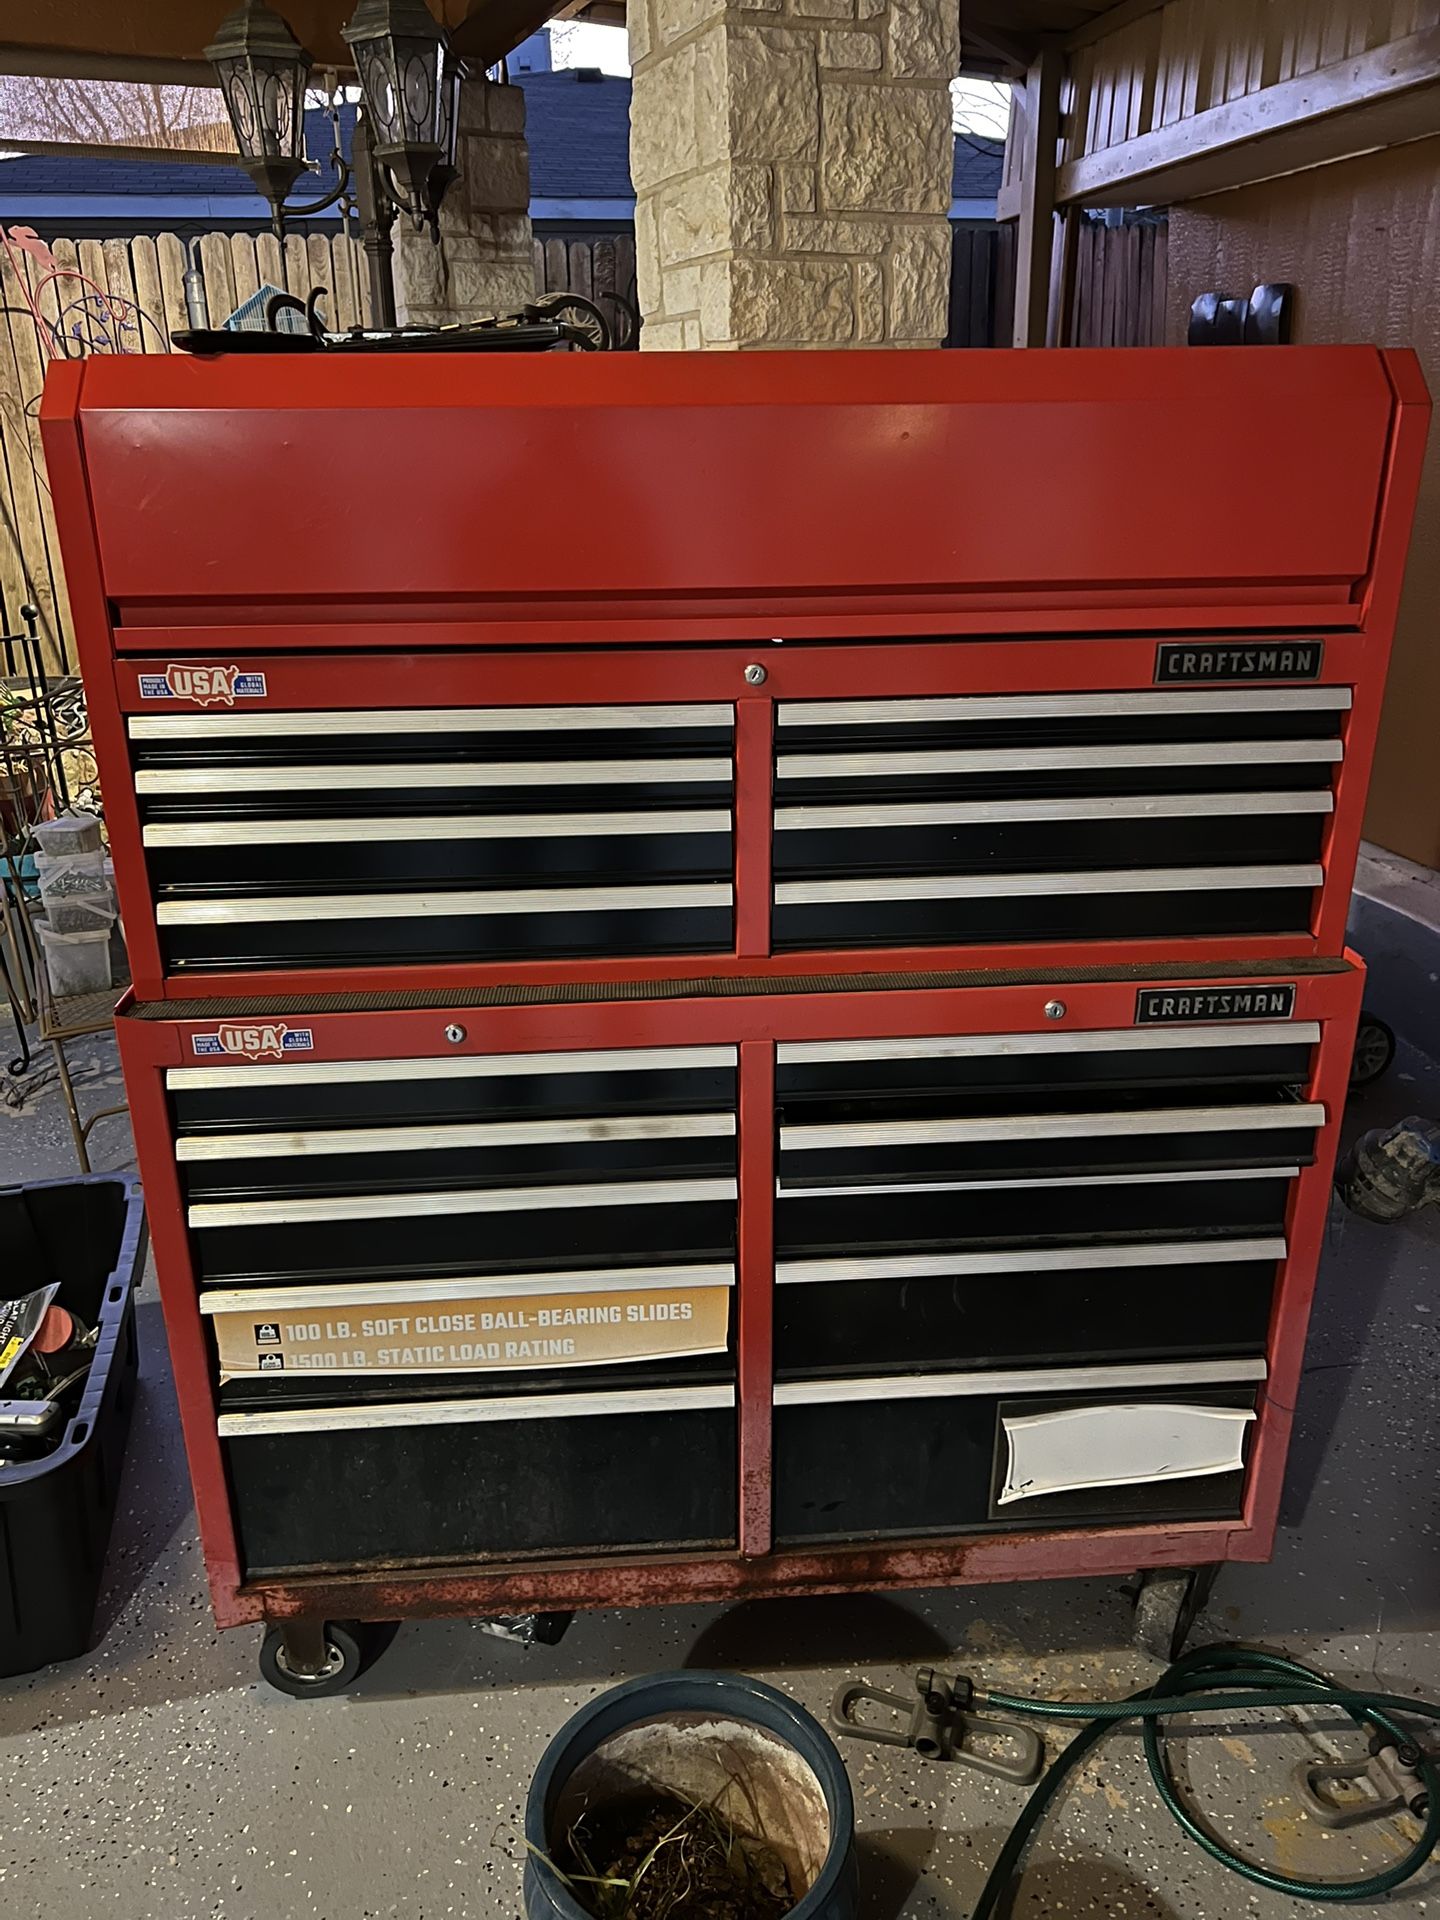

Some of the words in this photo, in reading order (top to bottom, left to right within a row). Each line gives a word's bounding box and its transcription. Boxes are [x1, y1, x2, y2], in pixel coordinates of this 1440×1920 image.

[1168, 650, 1312, 674] CRAFTSMAN
[173, 671, 231, 695] USA
[1148, 993, 1285, 1016] CRAFTSMAN
[225, 1029, 280, 1051] USA
[285, 1323, 321, 1342] 100
[326, 1321, 357, 1339] LB.
[362, 1317, 410, 1337] SOFT
[415, 1314, 477, 1334] CLOSE
[480, 1306, 622, 1330] BALL-BEARING
[626, 1303, 693, 1322] SLIDES
[289, 1352, 337, 1368] 1500
[342, 1350, 372, 1368] LB.
[378, 1346, 445, 1365] STATIC
[449, 1342, 500, 1361] LOAD
[505, 1338, 575, 1359] RATING
